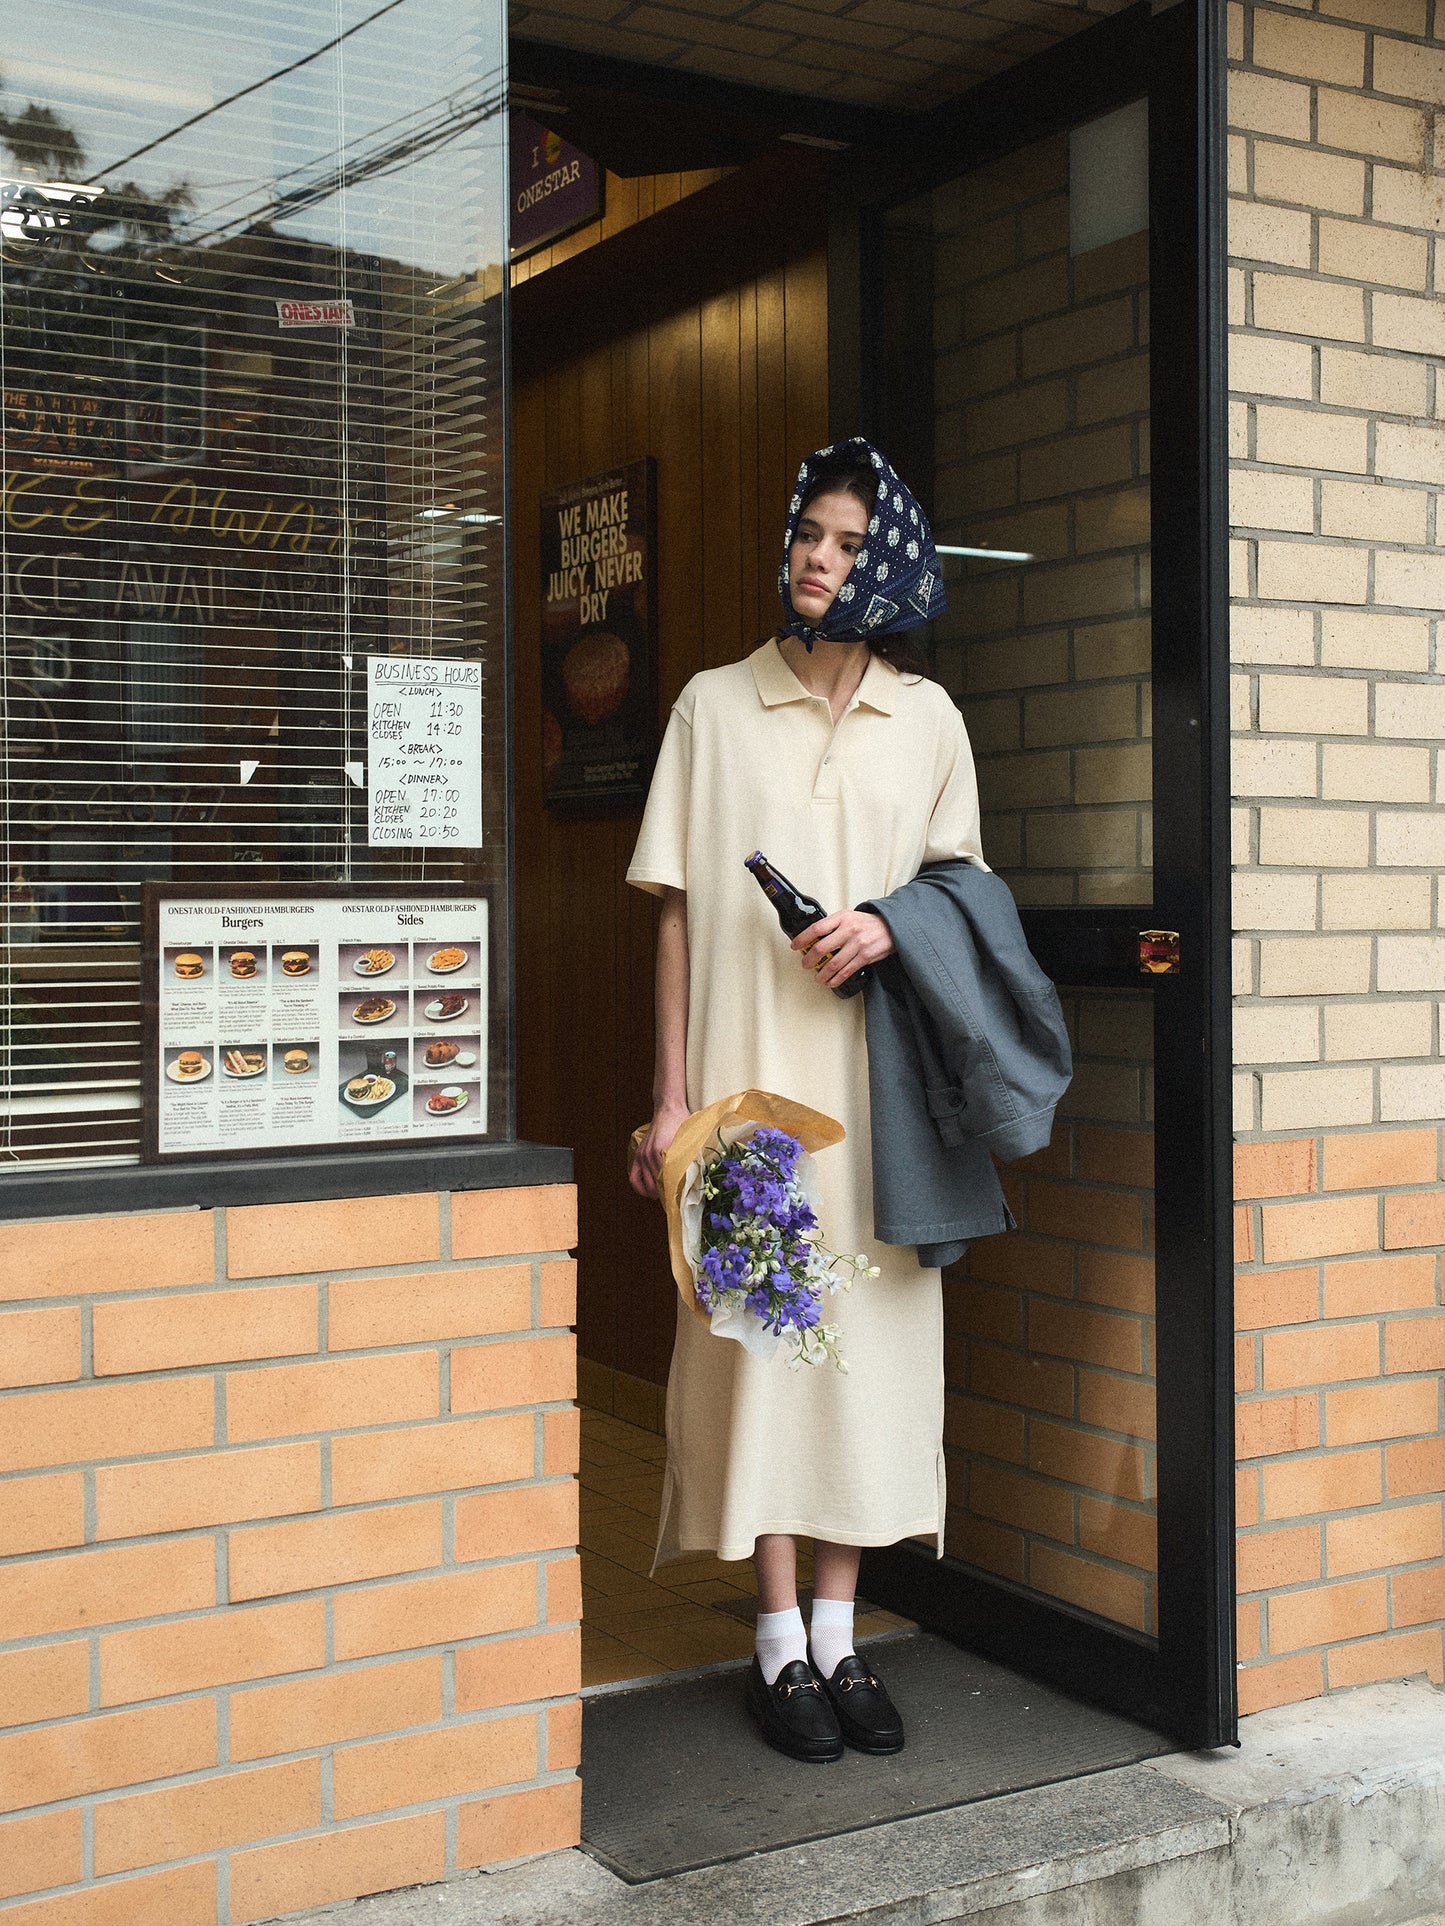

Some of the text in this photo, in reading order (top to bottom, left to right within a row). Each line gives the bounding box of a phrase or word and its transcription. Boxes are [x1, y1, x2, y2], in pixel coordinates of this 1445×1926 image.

[531, 145, 539, 169] I
[517, 160, 581, 214] ONESTAR
[281, 303, 351, 320] ONESTAR
[558, 506, 582, 539] WE
[586, 490, 629, 533] MAKE
[561, 522, 628, 569] BURGERS
[547, 550, 644, 602] JUICY, NEVER
[580, 590, 610, 625] DRY
[374, 663, 479, 684] BUSINESS HOURS
[373, 701, 463, 719] OPEN 11:30
[372, 720, 411, 731] KITCHEN
[427, 722, 462, 736] 14:20
[372, 730, 403, 740] CLOSES
[378, 757, 407, 770] 15:00
[429, 757, 463, 769] 17:00
[375, 788, 460, 804] OPEN 17:00
[374, 805, 411, 816] KITCHEN
[420, 806, 457, 819] 20:20
[374, 814, 404, 824] CLOSES
[372, 825, 460, 841] CLOSING 20:50
[168, 905, 315, 915] ONESTAR OLD-FASHIONED HAMBURGERS
[342, 904, 477, 913] ONESTAR OLD-FASHIONED HAMBURGERS
[222, 916, 264, 930] Burgers
[397, 913, 424, 926] Sides
